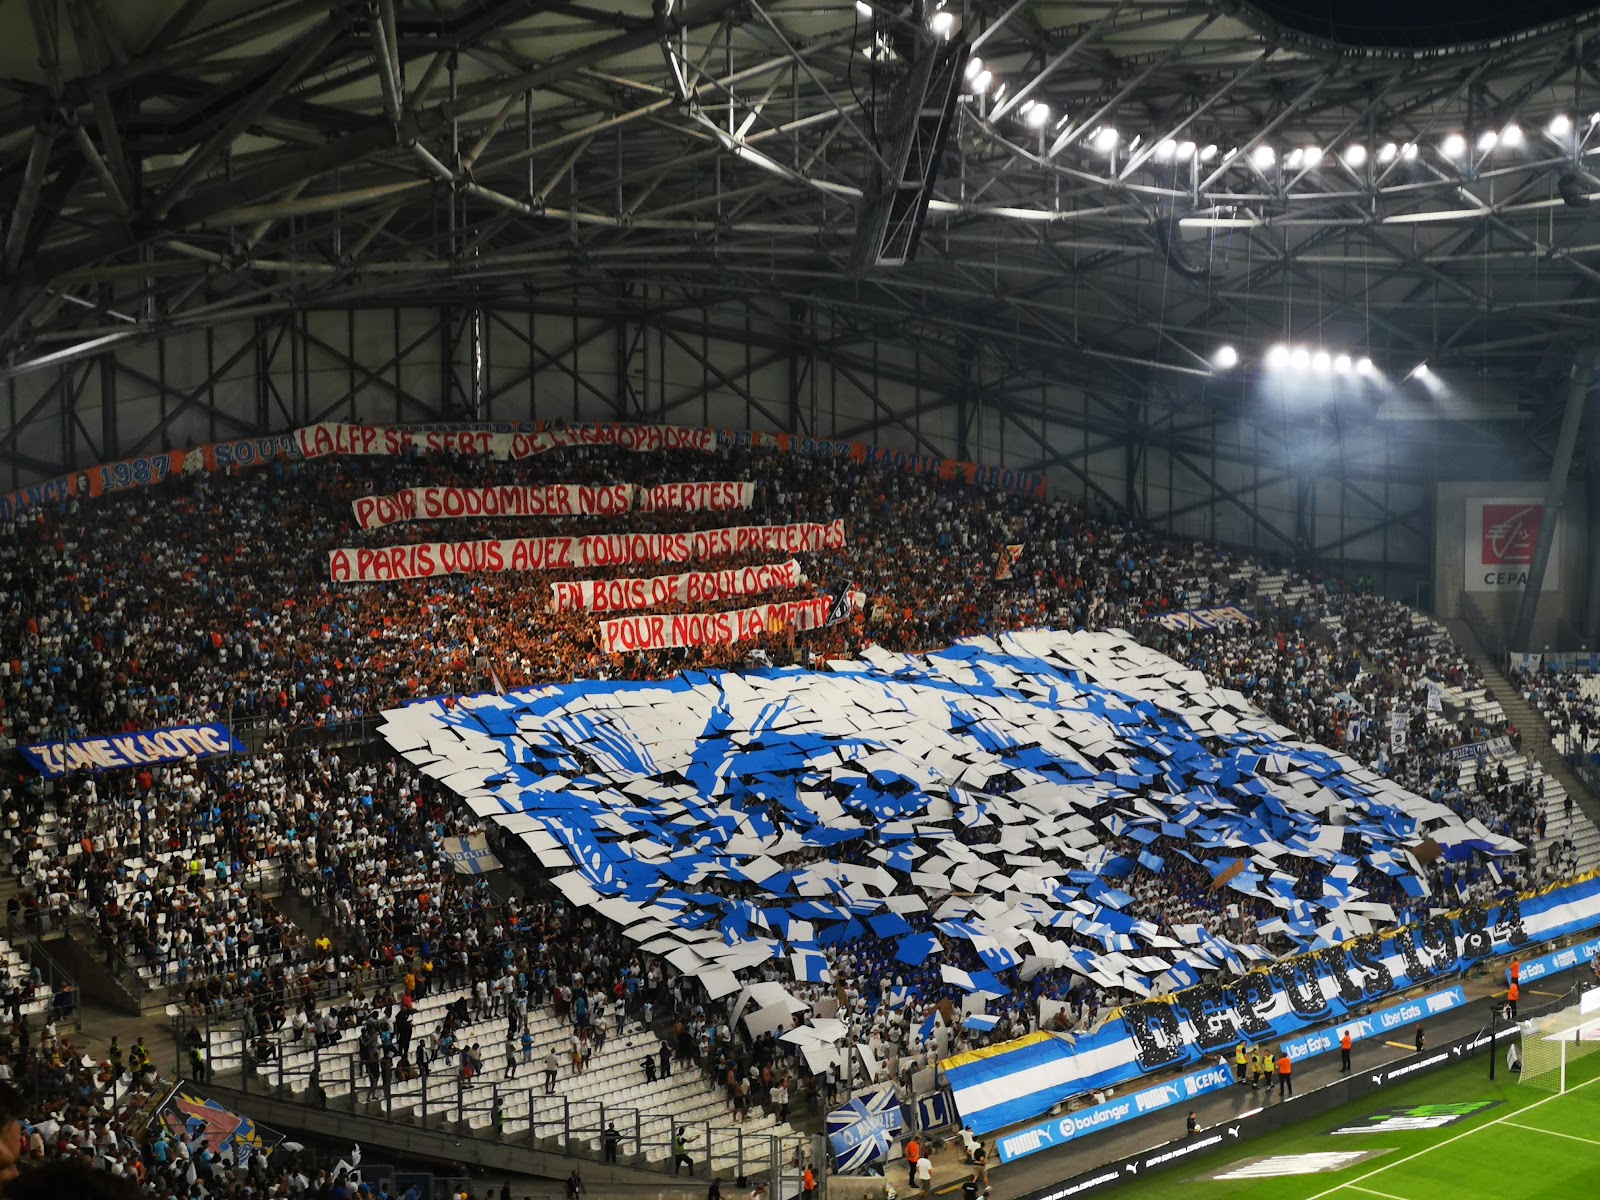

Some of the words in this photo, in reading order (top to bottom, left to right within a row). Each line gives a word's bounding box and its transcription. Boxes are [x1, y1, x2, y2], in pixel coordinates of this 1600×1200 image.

[100, 455, 171, 491] 1987
[425, 485, 571, 517] SODOMISER
[578, 484, 628, 514] NOS
[637, 482, 744, 513] IBERTES!
[331, 549, 350, 580] A
[357, 543, 435, 579] PARIS
[440, 539, 503, 572] VOUS
[579, 533, 691, 566] TOUJOURS
[695, 528, 731, 560] DES
[737, 520, 844, 553] PRETEXTES
[556, 583, 584, 610] EN
[593, 579, 647, 611] BOIS
[652, 575, 680, 606] DE
[687, 562, 796, 600] BOULOGNE
[1484, 572, 1528, 585] CEPA
[607, 616, 665, 651] POUR
[671, 613, 732, 646] NOUS
[738, 608, 764, 641] LA
[768, 591, 855, 632] METTR
[113, 727, 230, 764] KAOTIC
[1121, 937, 1395, 1072] DEPUIS
[1381, 1010, 1402, 1028] Uber
[1400, 1005, 1421, 1022] Eats
[1196, 1068, 1227, 1089] CEPAC
[1074, 1103, 1130, 1131] boulanger
